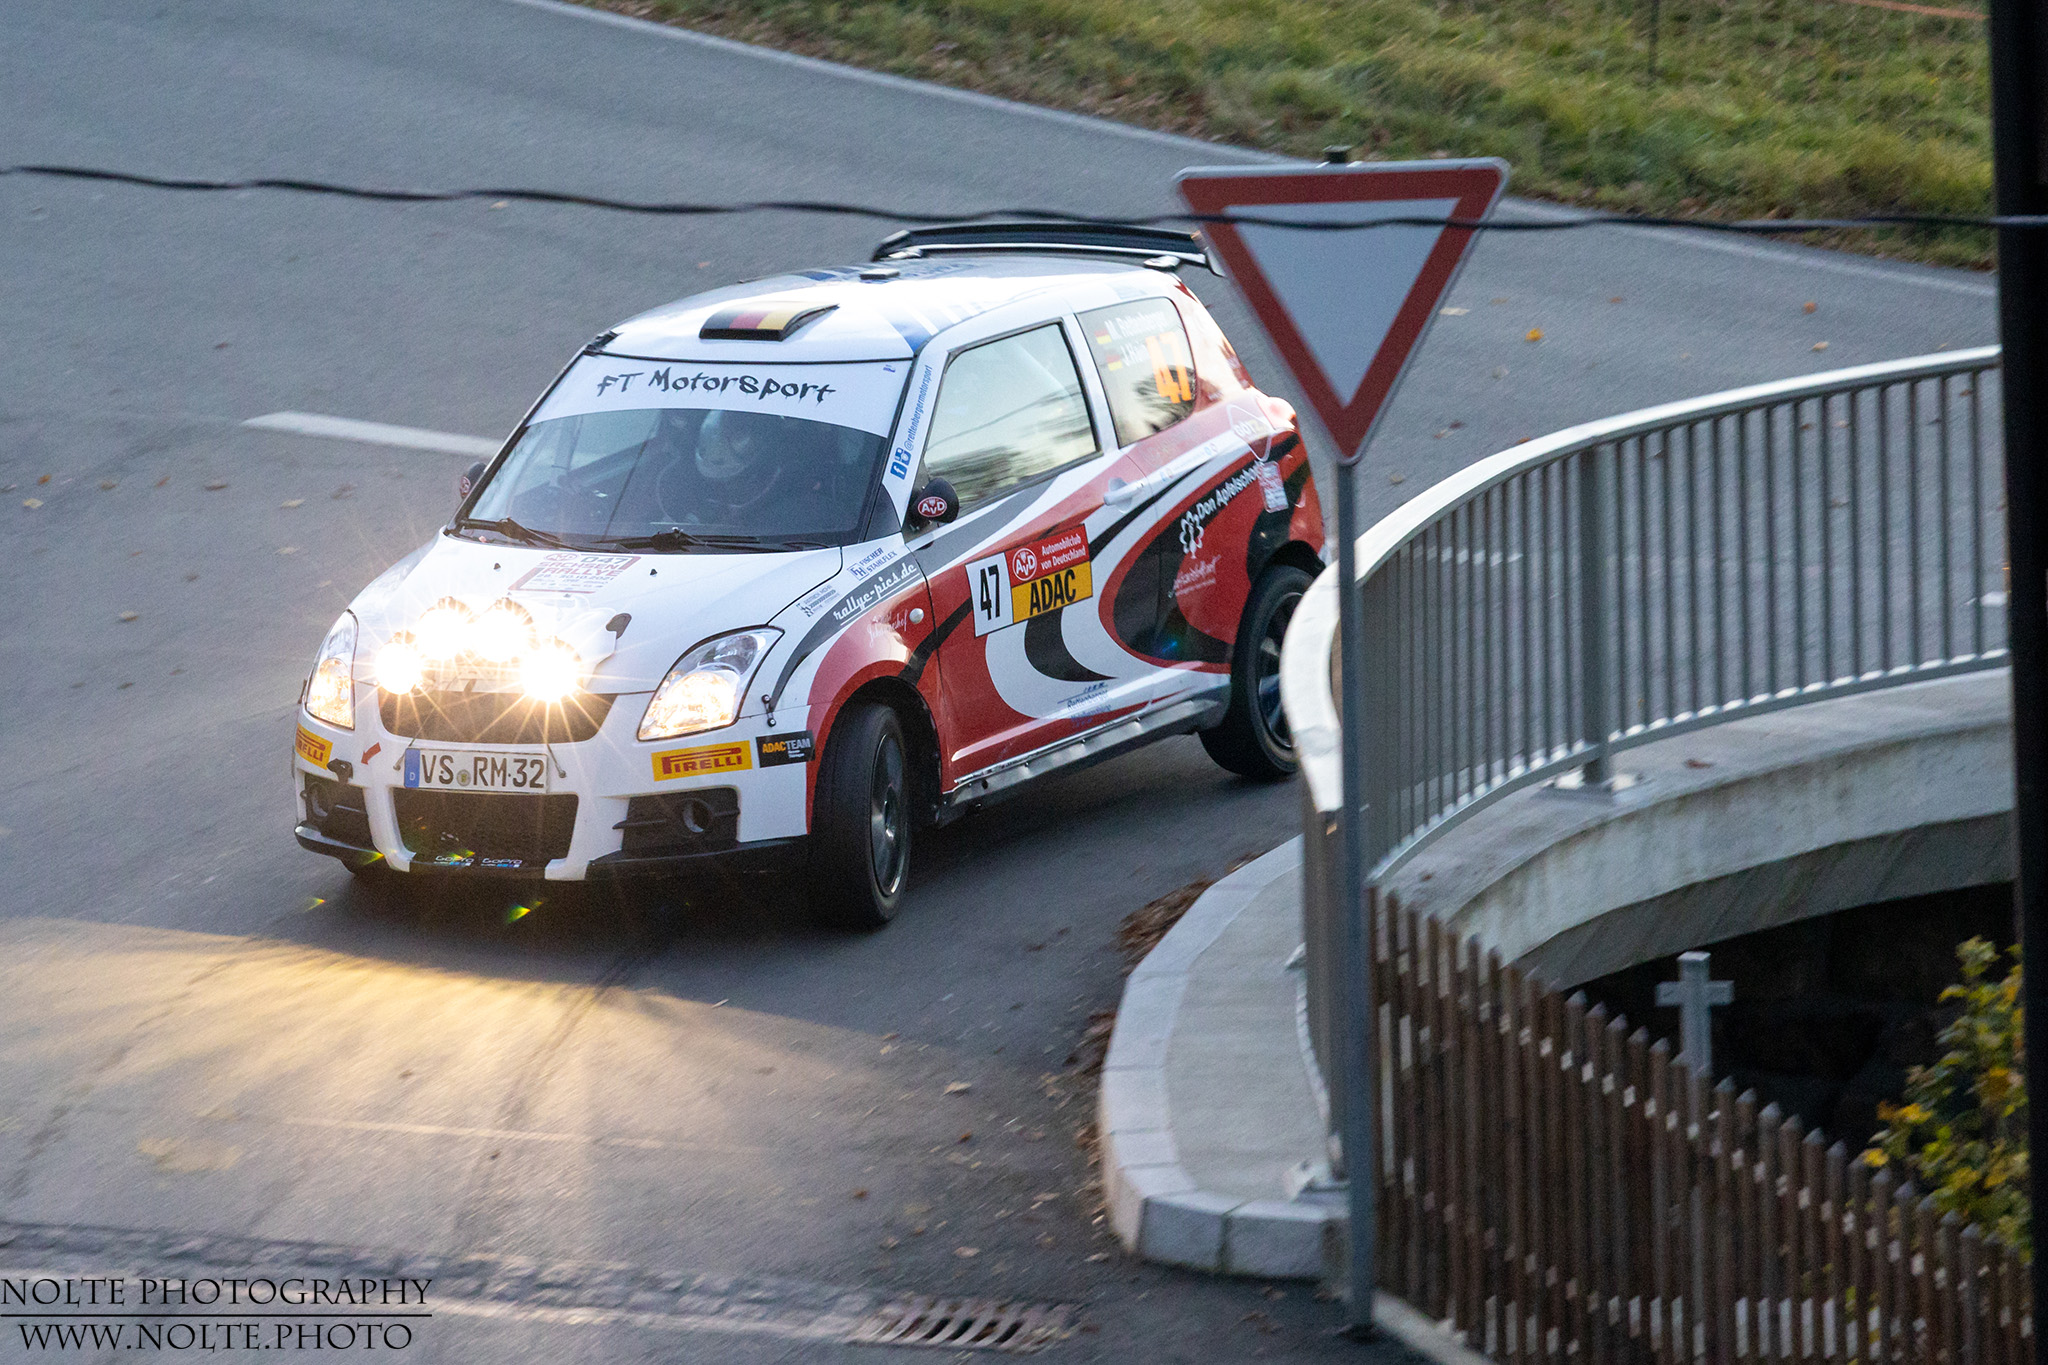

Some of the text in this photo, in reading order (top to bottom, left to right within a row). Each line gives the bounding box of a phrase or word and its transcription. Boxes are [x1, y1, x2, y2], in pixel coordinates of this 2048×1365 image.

[1145, 331, 1192, 404] 47
[597, 372, 644, 397] FT
[920, 501, 945, 516] AvD
[1196, 498, 1217, 520] Don
[860, 547, 884, 566] FISCHER
[1042, 533, 1082, 556] Automobilclub
[581, 556, 630, 564] 047
[866, 551, 898, 573] STAHLFLEX
[1016, 554, 1036, 576] AvD
[1041, 545, 1086, 570] von Deutschland
[542, 567, 623, 577] RALLYE
[833, 562, 918, 620] rallye-pics.de
[980, 564, 1000, 621] 47
[1030, 569, 1077, 616] ADAC
[421, 754, 454, 785] VS
[661, 747, 742, 775] PIRELLI
